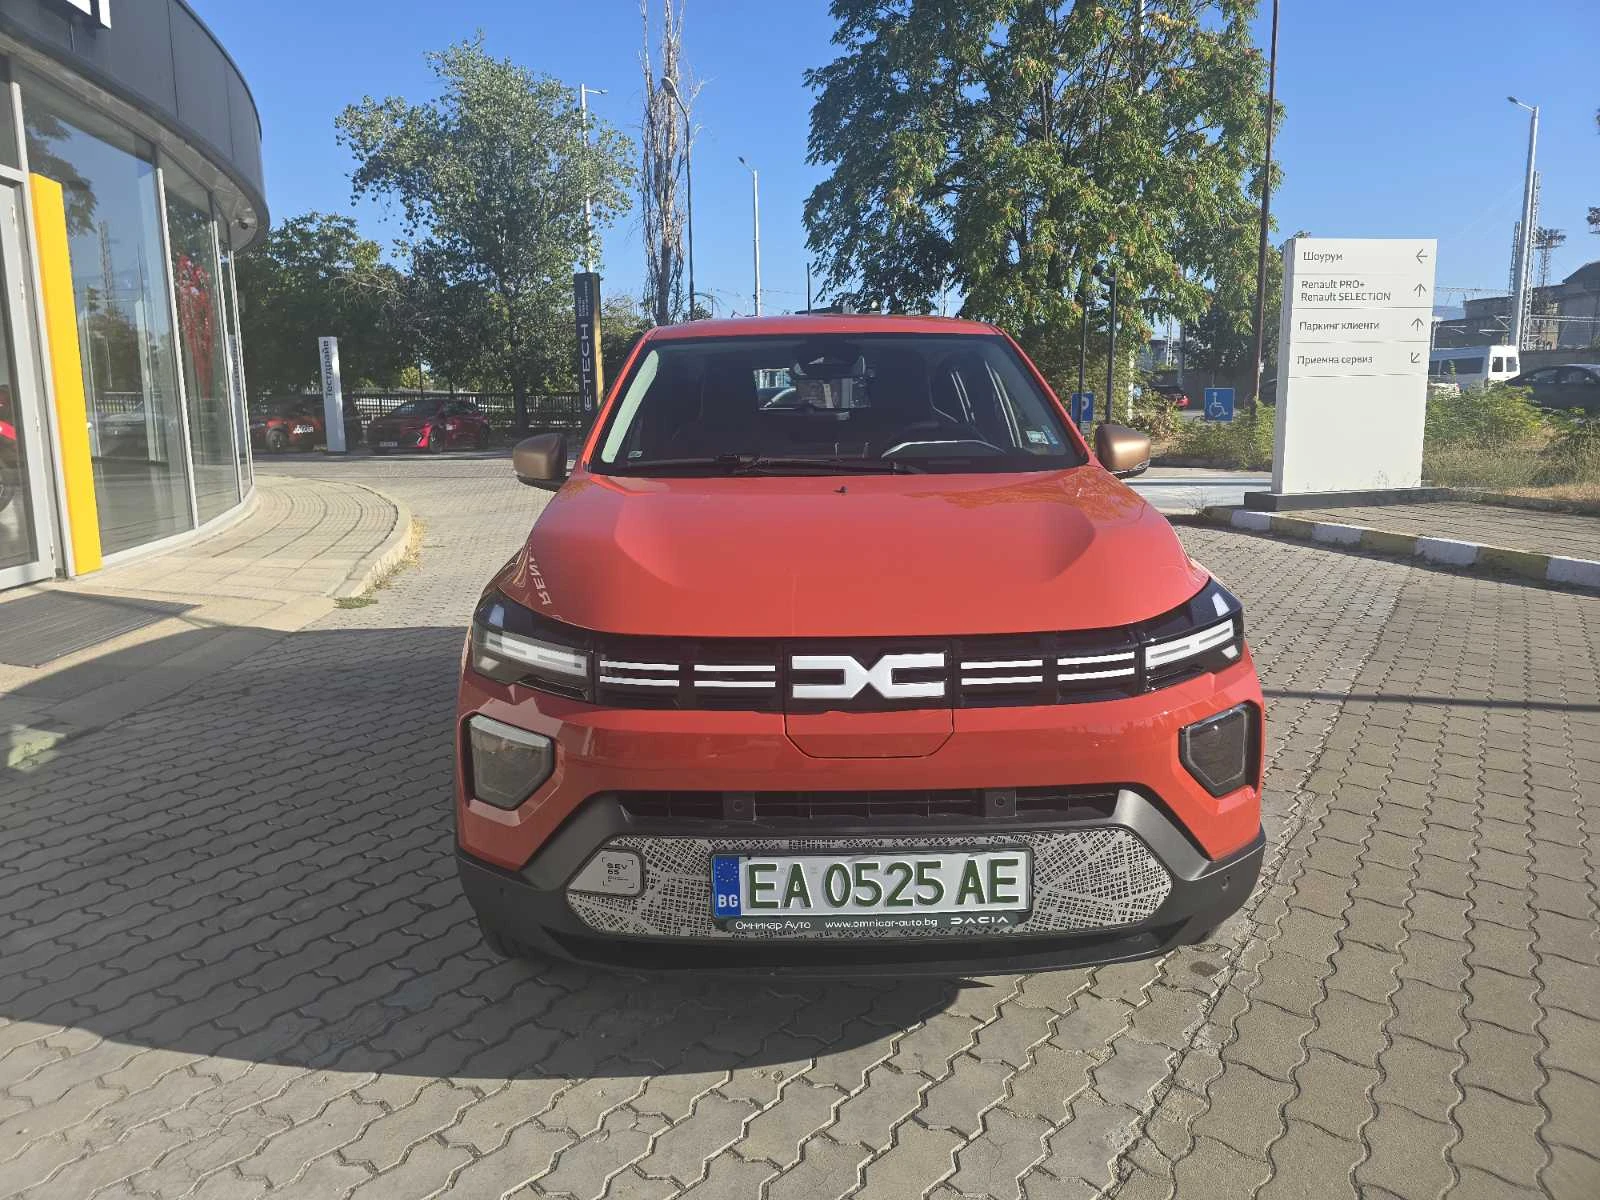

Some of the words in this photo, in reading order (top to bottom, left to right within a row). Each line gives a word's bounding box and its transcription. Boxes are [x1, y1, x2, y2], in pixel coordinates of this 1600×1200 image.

[1303, 251, 1343, 263] Шоурум
[1301, 280, 1337, 289] Renault
[1339, 280, 1365, 289] PRO+
[1301, 292, 1336, 301] Renault
[1338, 292, 1391, 301] SELECTION
[1299, 321, 1339, 332] Паркинг
[1341, 321, 1380, 330] клиенти
[1297, 355, 1339, 366] Приемна
[1341, 355, 1373, 365] сервиз
[580, 323, 592, 411] E-TECH
[747, 862, 813, 909] EA
[823, 860, 946, 909] 0525
[955, 857, 1020, 905] AE
[718, 894, 738, 908] BG
[735, 920, 782, 931] Омникар
[825, 917, 938, 928] www.omnicar-auto.bg
[950, 916, 1009, 925] DACIA
